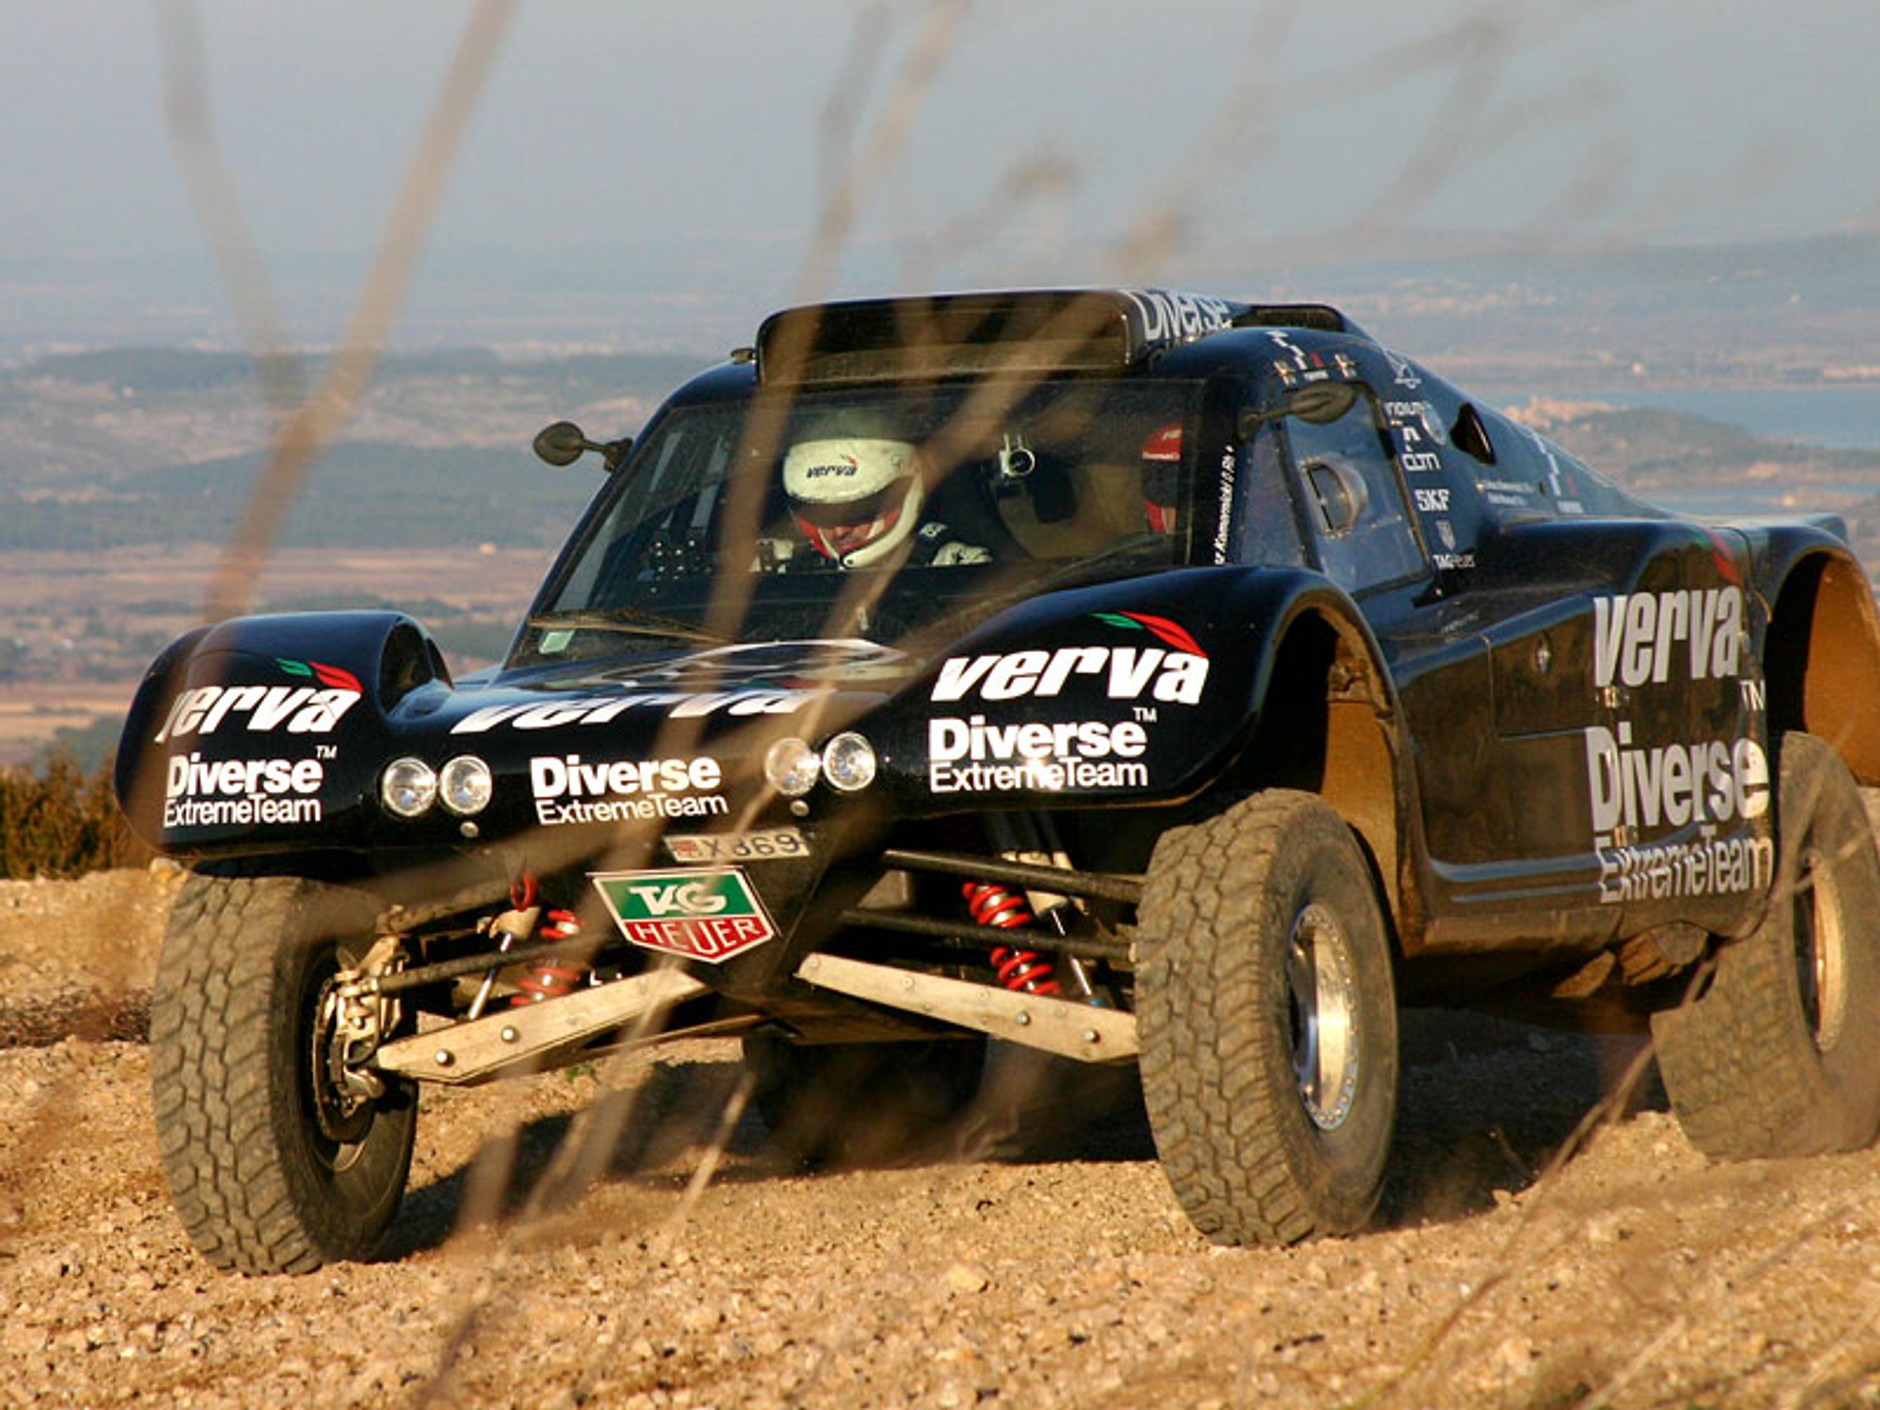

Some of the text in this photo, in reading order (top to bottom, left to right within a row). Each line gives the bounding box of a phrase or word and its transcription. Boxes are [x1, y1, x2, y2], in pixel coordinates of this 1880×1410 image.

[1414, 489, 1449, 511] SKF
[1593, 584, 1744, 687] verva
[930, 645, 1210, 704] verva
[1133, 706, 1157, 722] TM
[315, 745, 337, 758] TM
[929, 715, 1147, 763] Diverse
[165, 752, 323, 799] Diverse
[530, 754, 721, 799] Diverse
[930, 756, 1148, 793] ExtremeTeam
[1585, 721, 1769, 832] Diverse
[163, 793, 322, 828] ExtremeTeam
[534, 793, 729, 826] ExtremeTeam
[1594, 824, 1774, 904] ExtremeTeam
[633, 917, 761, 955] HEUER
